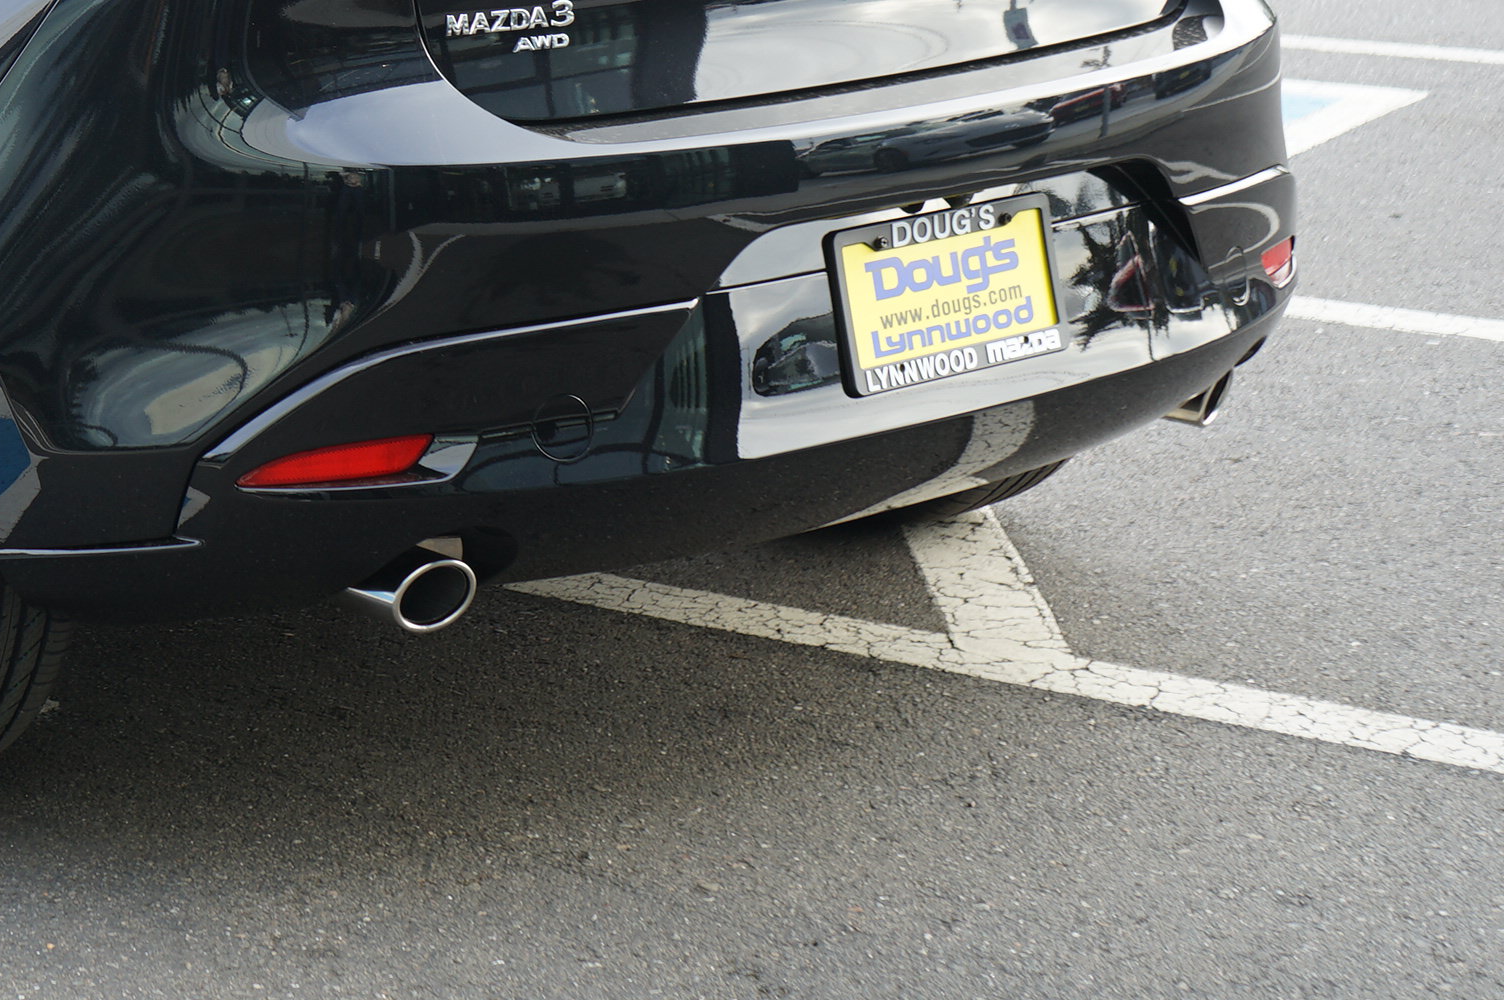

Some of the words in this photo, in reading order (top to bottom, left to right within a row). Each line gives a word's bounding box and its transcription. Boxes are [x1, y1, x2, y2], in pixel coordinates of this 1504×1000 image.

[512, 33, 570, 53] AWD
[892, 204, 996, 248] DOUG'S
[871, 296, 1034, 359] Lynnwood
[881, 284, 1023, 330] www.dougs.com
[865, 347, 978, 392] LYNNWOOD
